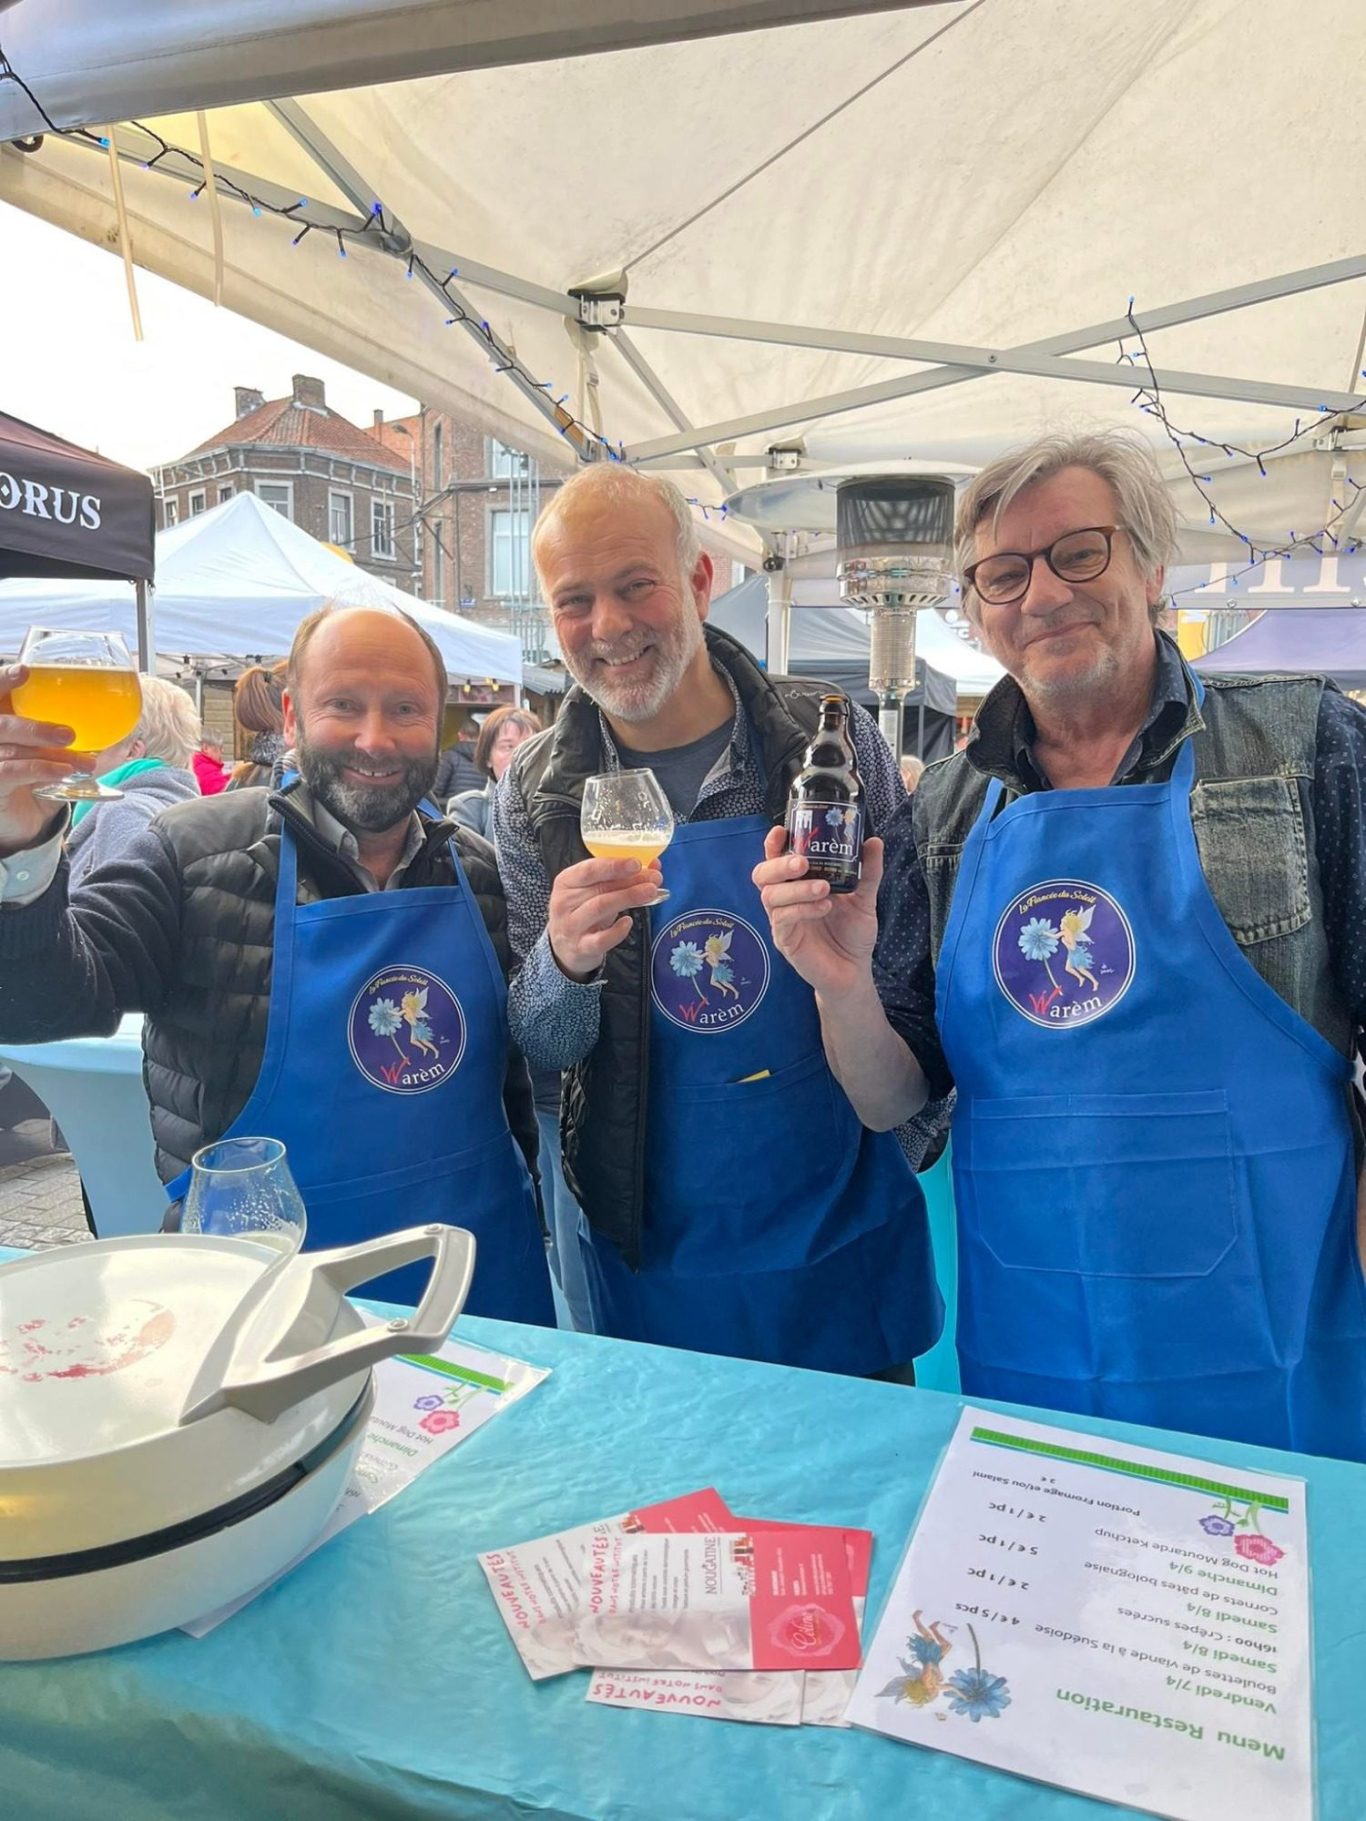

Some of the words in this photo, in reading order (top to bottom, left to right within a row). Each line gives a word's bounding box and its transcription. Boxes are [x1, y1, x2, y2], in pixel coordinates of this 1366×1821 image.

[679, 997, 744, 1024] Warèm
[1029, 985, 1103, 1019] Warèm
[380, 1057, 446, 1086] Warèm
[972, 1470, 1009, 1485] Salami
[1012, 1480, 1041, 1492] et/ou
[1043, 1488, 1094, 1506] Fromage
[988, 1502, 1006, 1512] pc
[1096, 1500, 1140, 1516] Portion
[978, 1534, 997, 1544] pc
[1094, 1528, 1148, 1548] Ketchup
[1151, 1542, 1218, 1565] Moutarde
[703, 1536, 718, 1595] NOUGATINE
[967, 1568, 986, 1578] pc
[1084, 1561, 1158, 1587] bolognaise
[1168, 1561, 1193, 1574] 9/4
[1222, 1558, 1249, 1573] Dog
[1253, 1567, 1278, 1580] Hot
[589, 1536, 609, 1614] NOUVEAUTÉS
[1197, 1570, 1278, 1596] Dimanche
[486, 1553, 530, 1632] NOUVEAUTÉS
[1161, 1580, 1199, 1596] pâtes
[1202, 1590, 1220, 1602] de
[954, 1603, 979, 1615] pcs
[1186, 1602, 1212, 1618] 8/4
[1224, 1596, 1278, 1616] Cornets
[1011, 1616, 1020, 1626] 4
[1117, 1607, 1170, 1627] sucrées
[1216, 1611, 1278, 1634] Samedi
[1034, 1624, 1098, 1649] Suédoise
[1174, 1622, 1223, 1641] Crêpes
[1102, 1642, 1115, 1654] la
[1118, 1646, 1126, 1656] à
[1182, 1640, 1209, 1657] 8/4
[1234, 1637, 1277, 1654] 16h00
[1130, 1650, 1178, 1668] viande
[1213, 1650, 1277, 1674] Samedi
[1182, 1663, 1200, 1676] de
[652, 1678, 691, 1688] NOTRE
[694, 1682, 723, 1692] DANS
[1165, 1675, 1192, 1691] 7/4
[1204, 1669, 1277, 1695] Boulettes
[592, 1683, 721, 1707] NOUVEAUTÉS
[1196, 1685, 1276, 1714] Vendredi
[1056, 1689, 1204, 1739] Restauration
[1217, 1731, 1285, 1761] Menu
